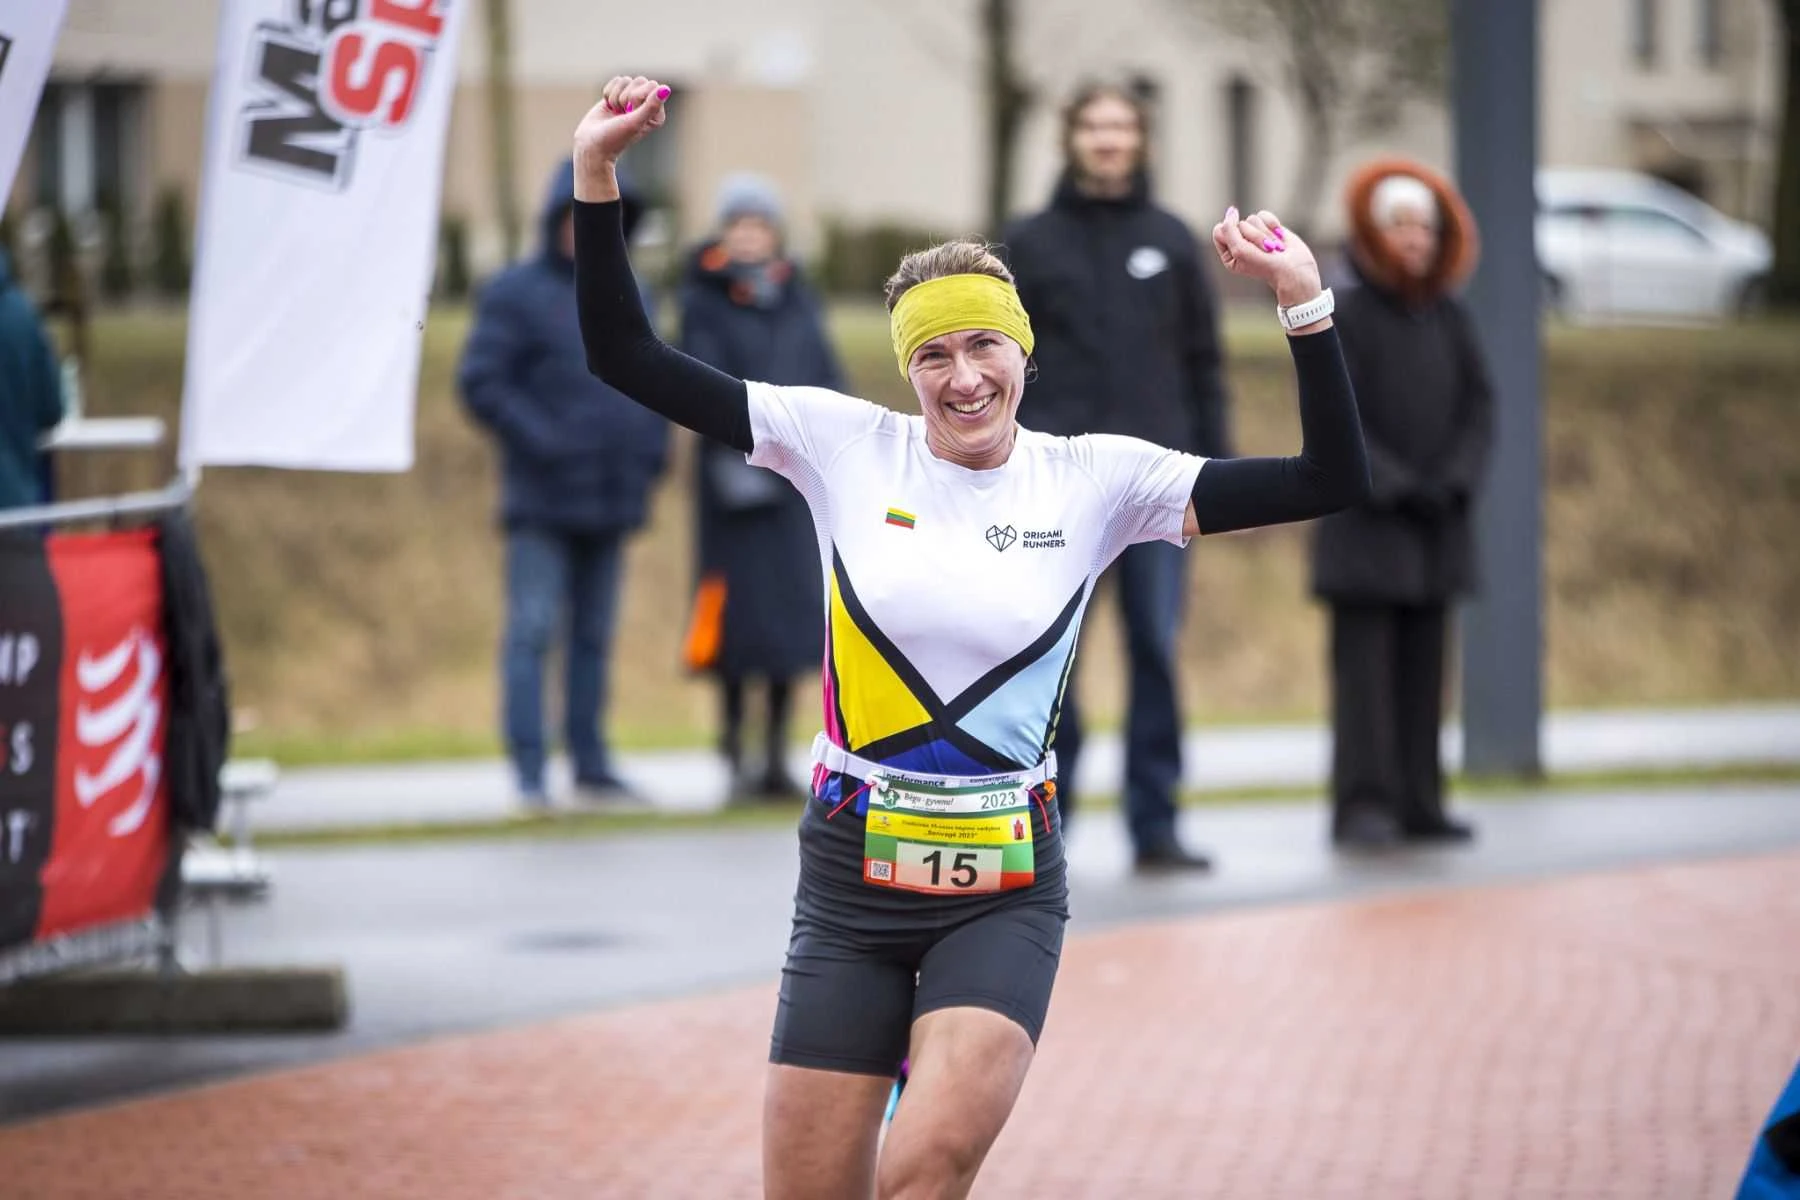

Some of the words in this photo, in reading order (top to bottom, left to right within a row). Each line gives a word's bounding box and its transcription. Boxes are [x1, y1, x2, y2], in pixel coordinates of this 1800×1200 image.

[1023, 530, 1062, 539] ORIGAMI
[1023, 539, 1065, 549] RUNNERS
[981, 791, 1016, 810] 2023
[923, 850, 978, 888] 15
